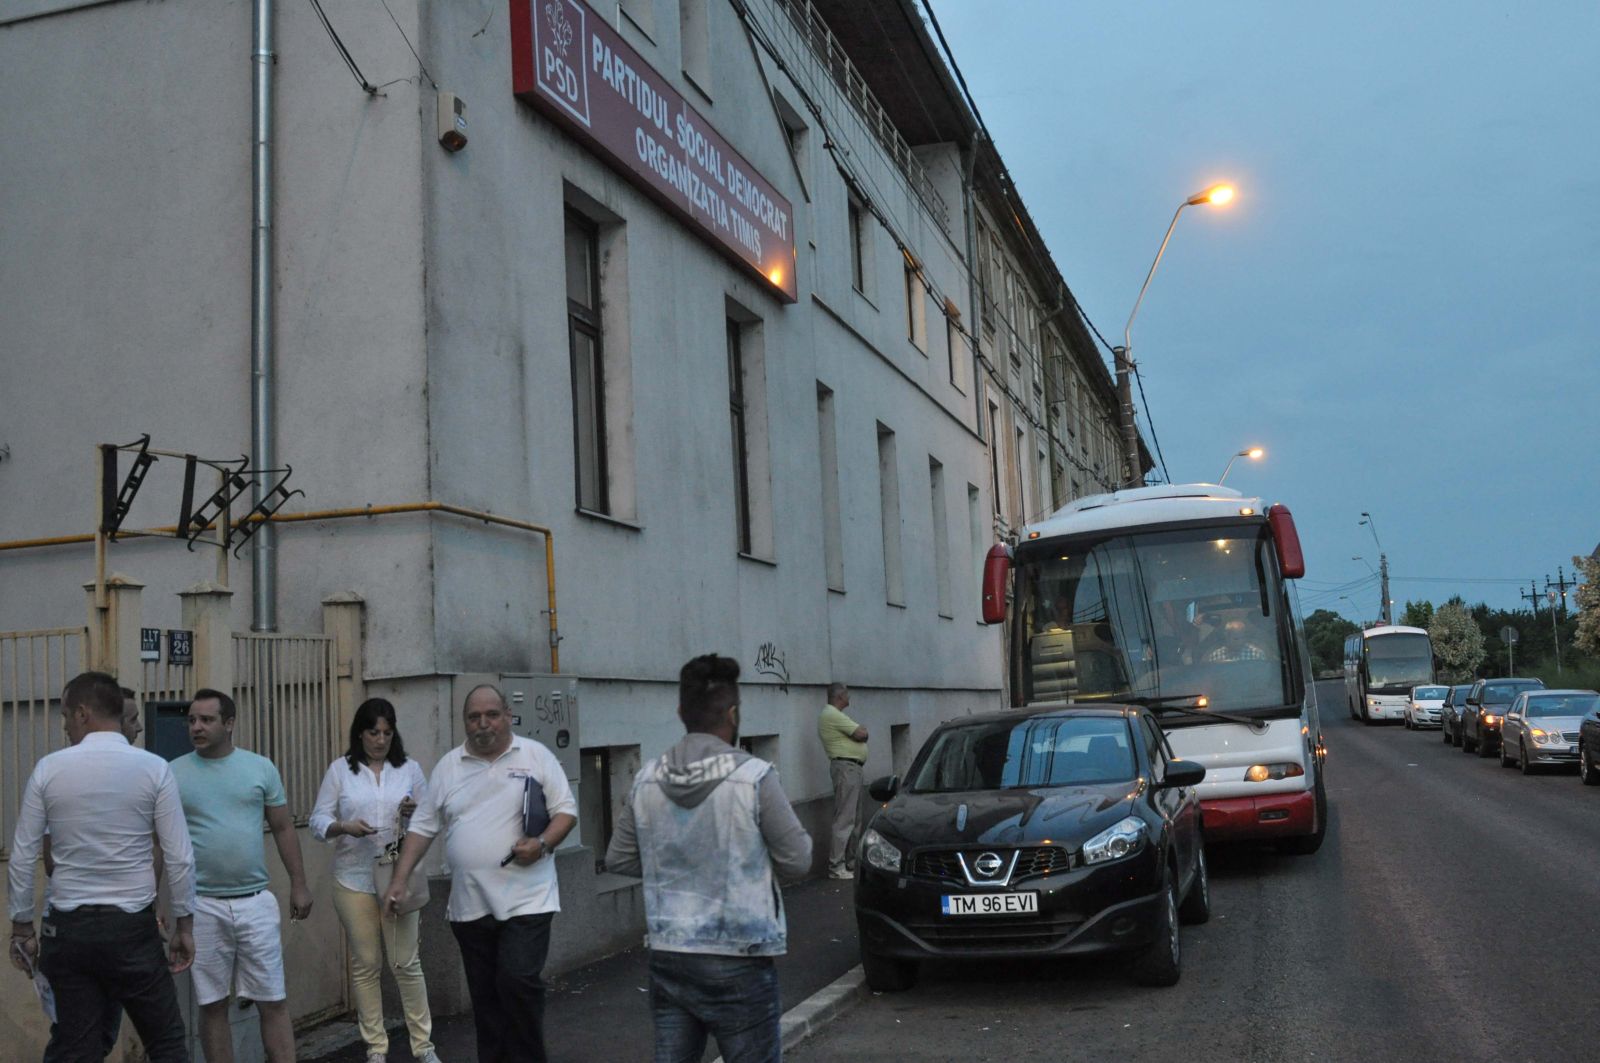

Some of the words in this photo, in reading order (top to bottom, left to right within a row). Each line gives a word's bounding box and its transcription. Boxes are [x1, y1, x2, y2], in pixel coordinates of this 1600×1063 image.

[545, 46, 578, 102] PSD
[592, 33, 673, 139] PARTIDUL
[676, 113, 725, 187] SOCIAL
[728, 161, 787, 241] DEMOCRAT
[173, 640, 190, 655] 26
[953, 897, 977, 912] TM
[982, 896, 1002, 911] 96
[1005, 895, 1034, 911] EVI
